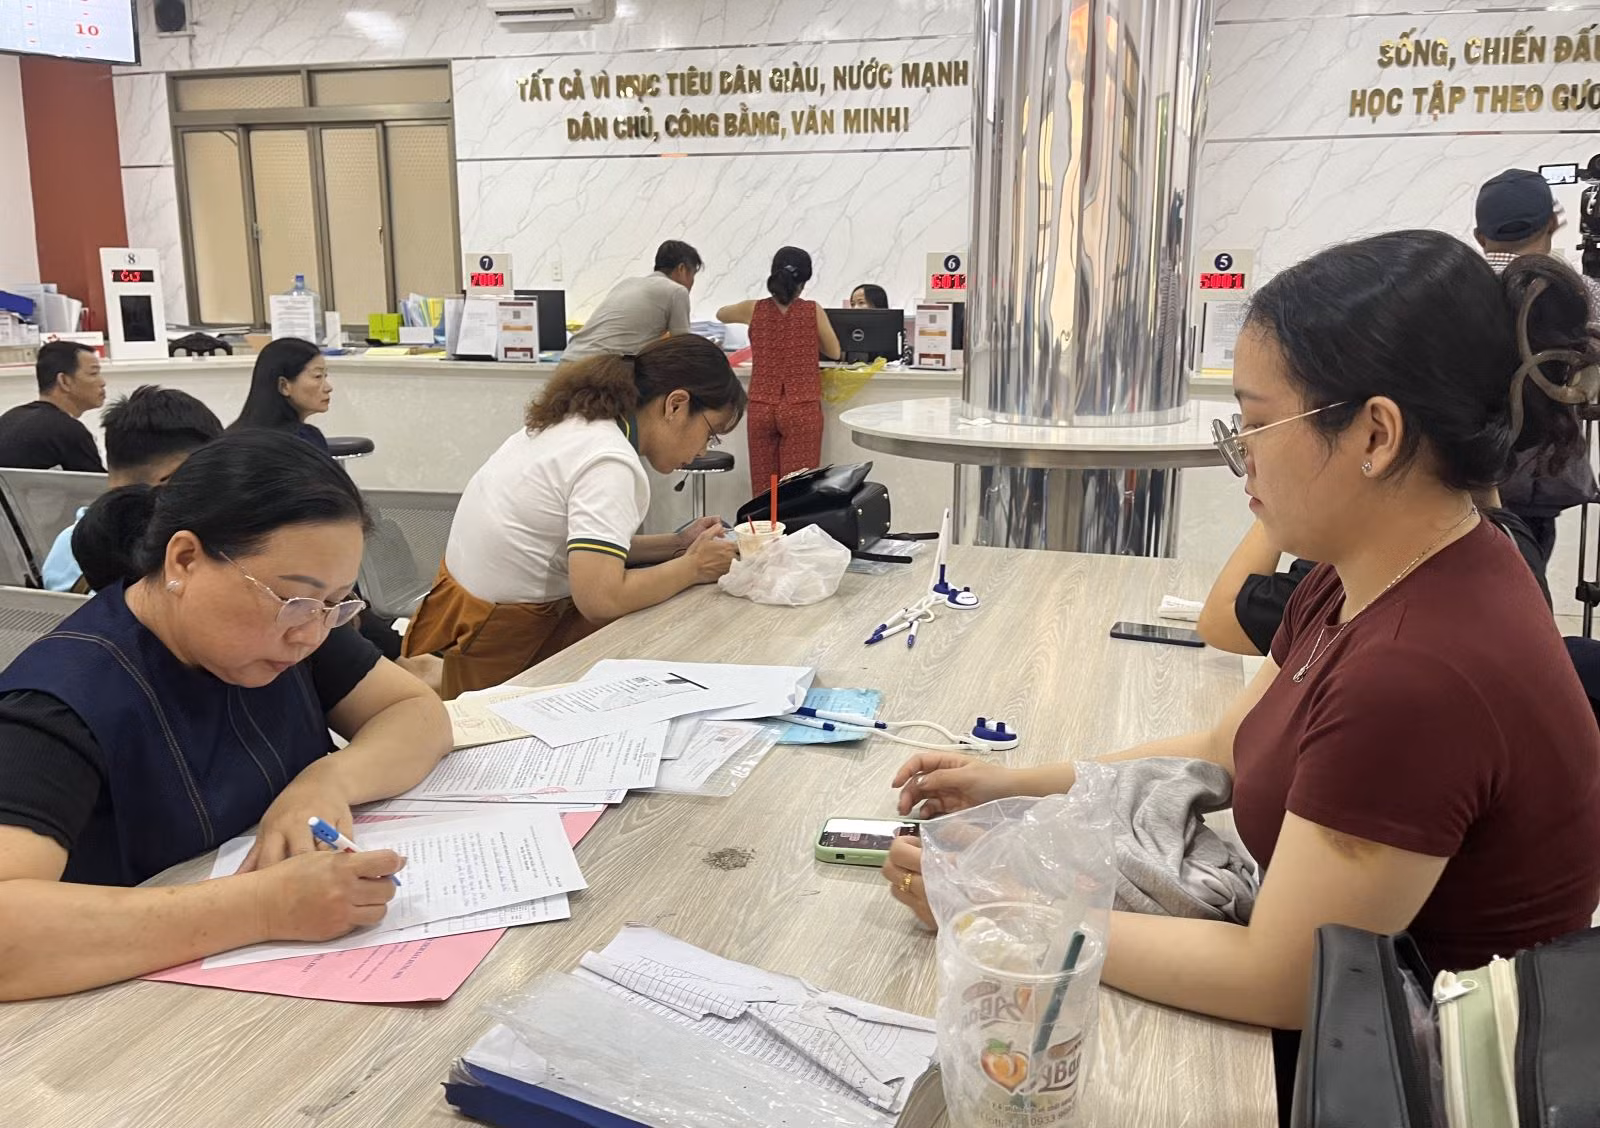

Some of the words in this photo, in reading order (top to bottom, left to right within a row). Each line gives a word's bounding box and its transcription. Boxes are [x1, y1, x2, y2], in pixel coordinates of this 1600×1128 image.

[75, 23, 100, 36] 10
[1377, 27, 1456, 70] SỐNG,
[1463, 25, 1546, 65] CHIẾN
[516, 68, 554, 102] TẤT
[559, 68, 585, 101] CẢ
[590, 69, 610, 99] VÌ
[615, 74, 661, 103] MỤC
[666, 65, 713, 96] TIÊU
[719, 64, 762, 95] DÂN
[769, 61, 826, 96] GIÀU,
[833, 57, 893, 91] NƯỚC
[901, 60, 968, 93] MẠNH
[1349, 88, 1404, 124] HỌC
[1412, 80, 1466, 121] TẬP
[1473, 84, 1544, 114] THEO
[567, 111, 608, 141] DÂN
[613, 107, 660, 142] CHỦ,
[664, 108, 719, 138] CÔNG
[724, 102, 787, 140] BẰNG,
[791, 105, 835, 135] VĂN
[843, 106, 910, 134] MINH!
[127, 253, 137, 265] 8
[947, 257, 957, 270] 6
[1219, 255, 1230, 268] 5
